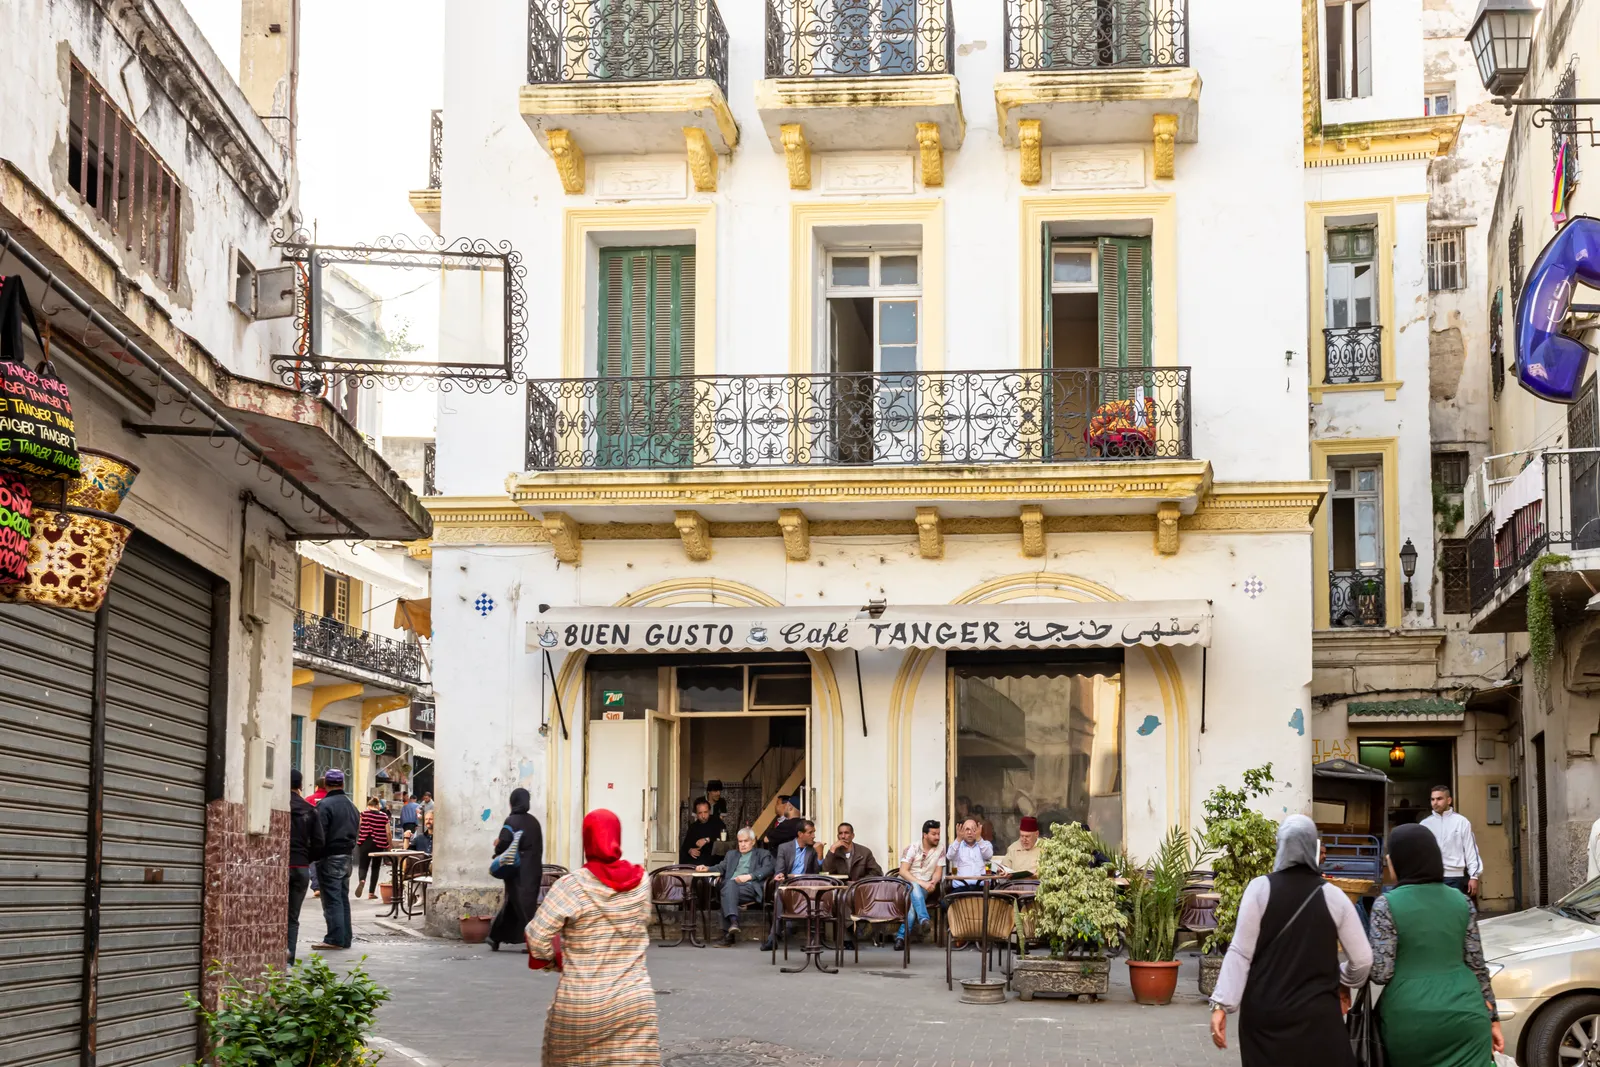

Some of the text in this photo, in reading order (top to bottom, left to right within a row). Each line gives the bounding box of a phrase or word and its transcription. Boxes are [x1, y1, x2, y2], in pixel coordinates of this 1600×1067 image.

[0, 361, 39, 387] TANGER
[9, 398, 53, 422] TANGER
[26, 386, 64, 410] TANGER
[36, 424, 70, 448] TANGER
[13, 439, 51, 460] TANGER
[565, 621, 1002, 647] BUEN GUSTO Café TANGER
[1014, 617, 1200, 644] مقهى طنجة
